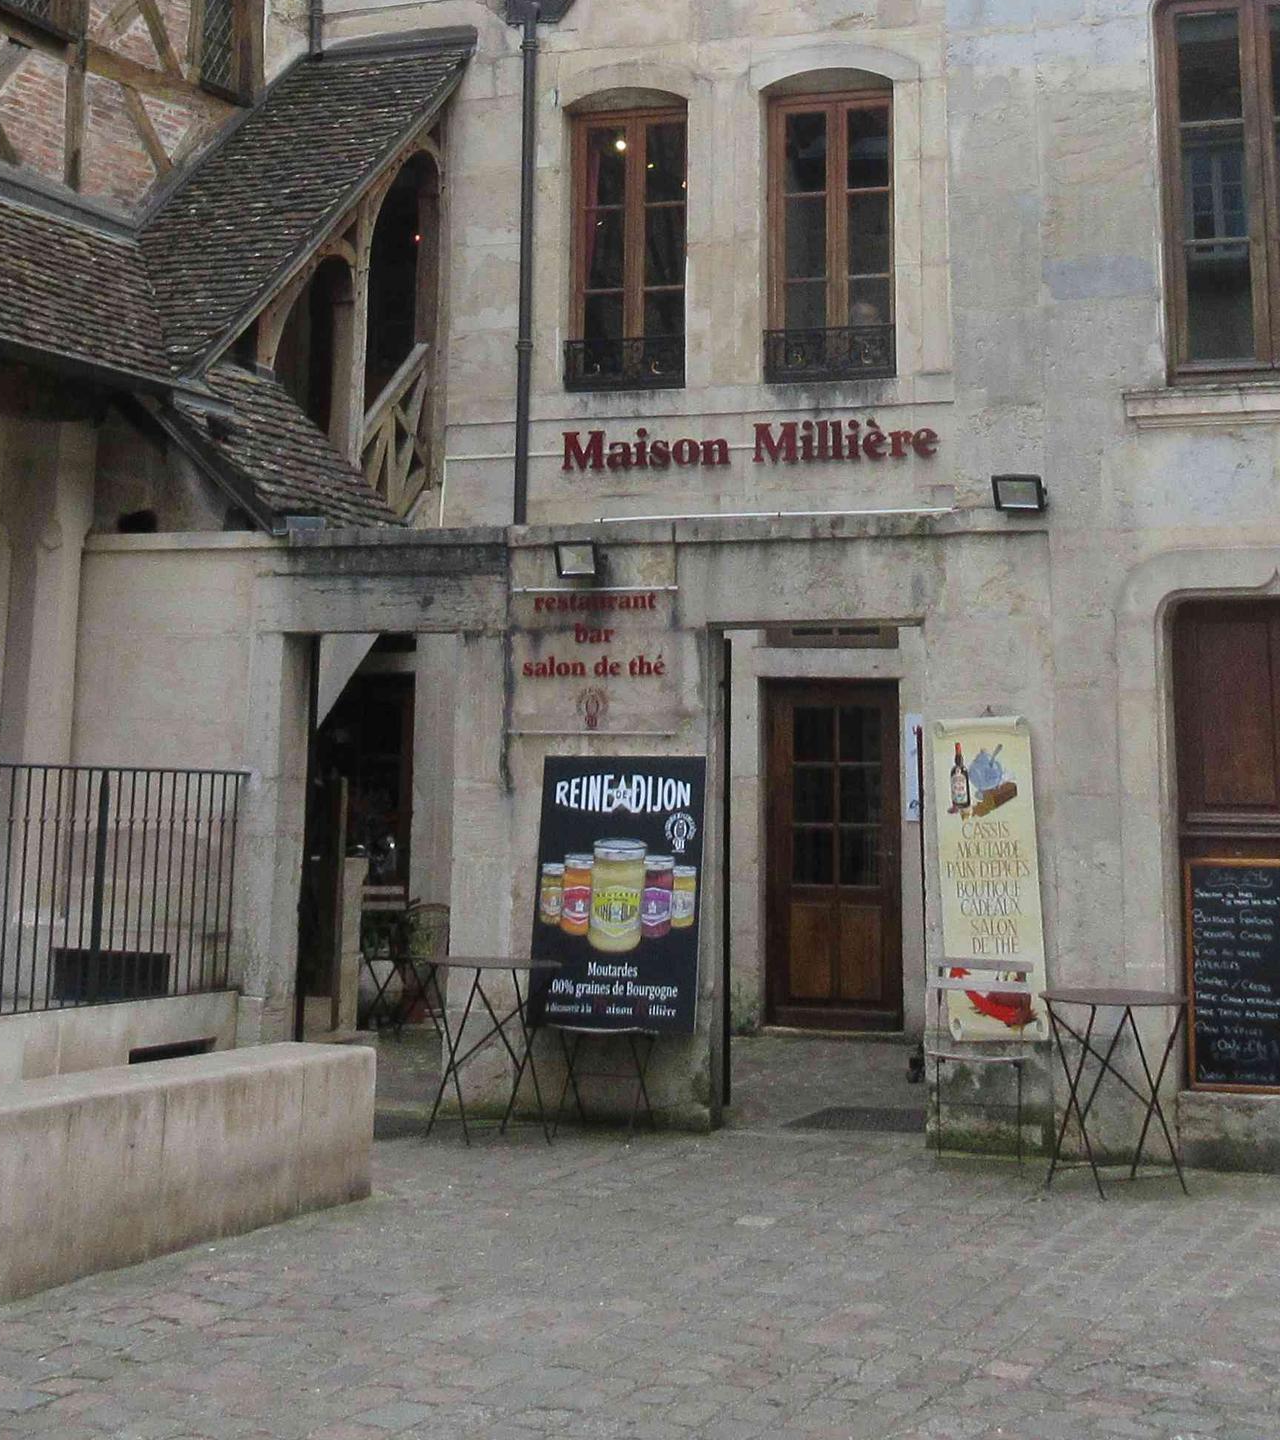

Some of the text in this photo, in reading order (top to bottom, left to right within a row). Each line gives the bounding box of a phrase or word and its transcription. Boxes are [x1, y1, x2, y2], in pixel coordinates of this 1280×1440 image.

[561, 418, 940, 471] Maison Millière
[533, 592, 658, 612] restaurant
[574, 623, 616, 644] bar
[522, 654, 666, 678] salon de thé
[555, 774, 691, 813] REINE DE DIJON
[962, 821, 1009, 839] CASSIS
[957, 840, 1020, 858] MOUTARDE
[947, 861, 976, 878] PAIN
[957, 880, 1021, 898] BOUTIQUE
[961, 898, 1022, 916] CADEAUX
[971, 918, 1017, 936] SALON
[972, 937, 990, 954] DE
[588, 962, 638, 978] Moutardes
[548, 978, 678, 1000] 00% graines de Bourgogne
